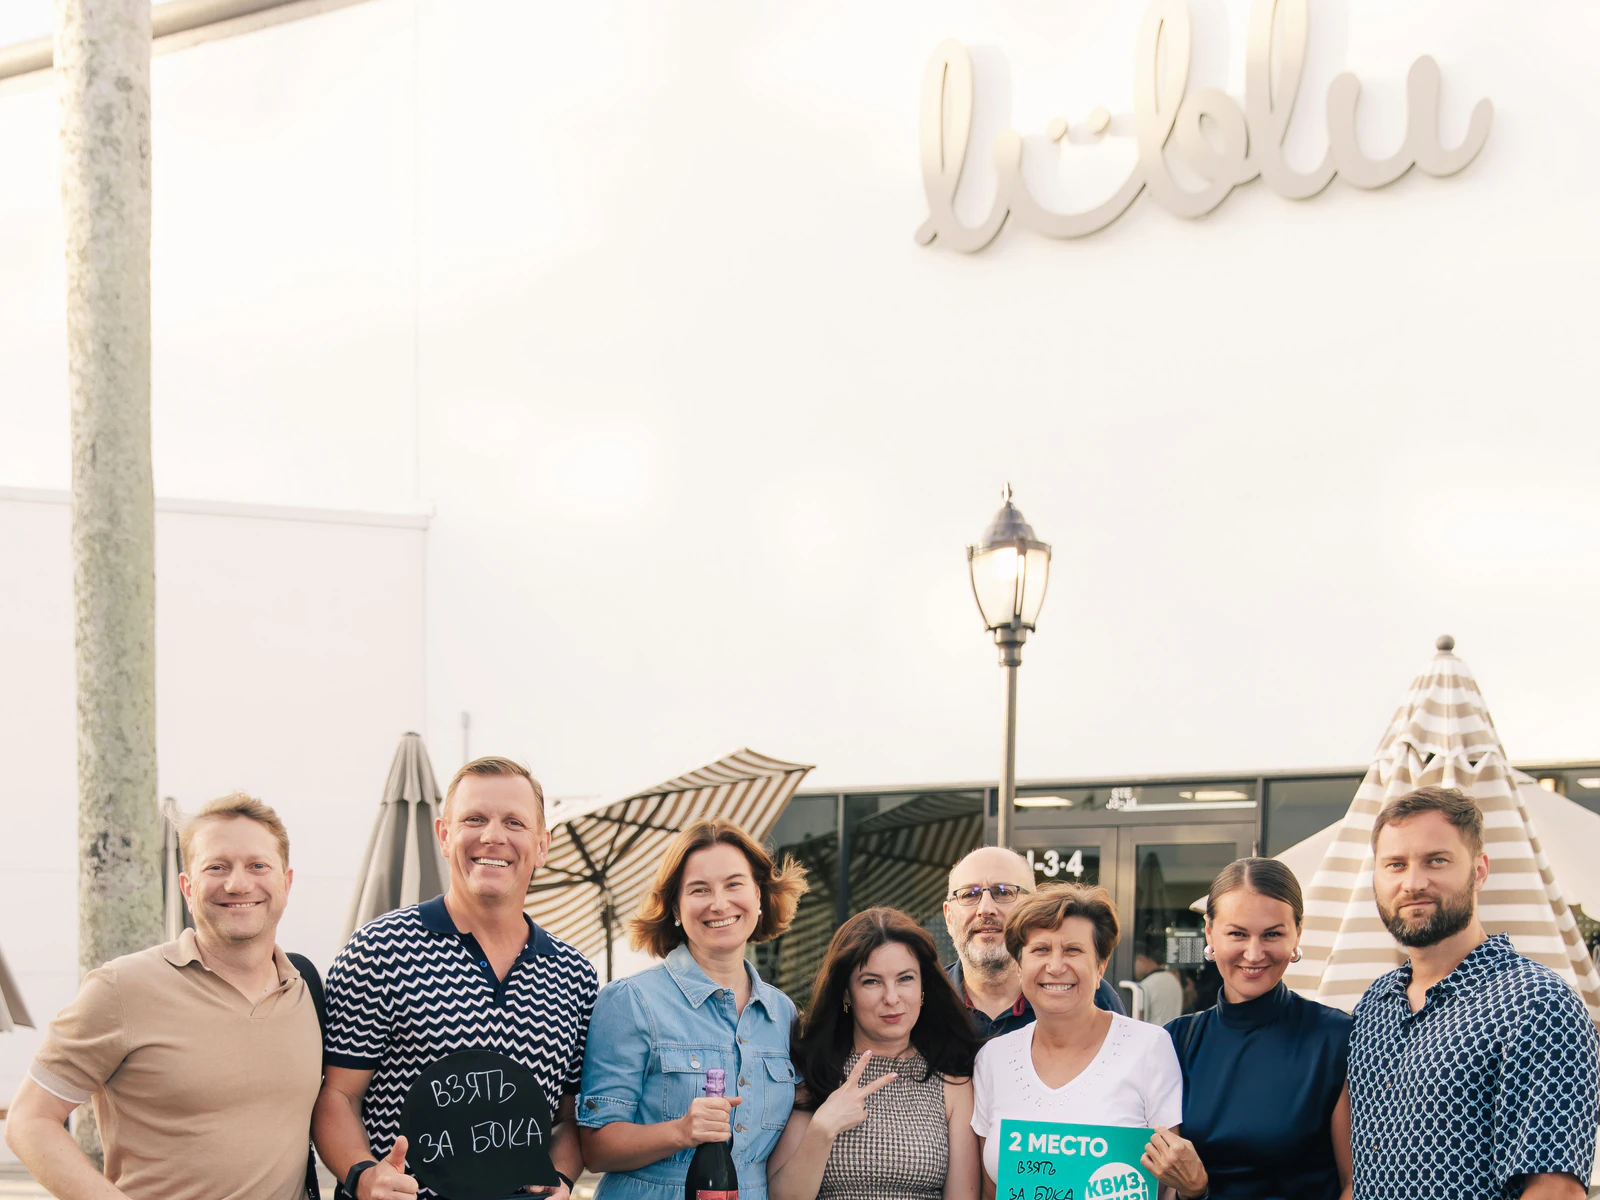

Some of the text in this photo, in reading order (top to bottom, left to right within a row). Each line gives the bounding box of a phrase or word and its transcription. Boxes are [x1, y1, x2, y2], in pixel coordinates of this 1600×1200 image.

[430, 1069, 517, 1107] ВЗЯТЬ
[418, 1117, 543, 1163] ЗА БОКА
[1008, 1131, 1109, 1158] 2 МЕСТО
[1017, 1160, 1057, 1175] ВЗЯТЬ
[1009, 1187, 1025, 1200] ЗА
